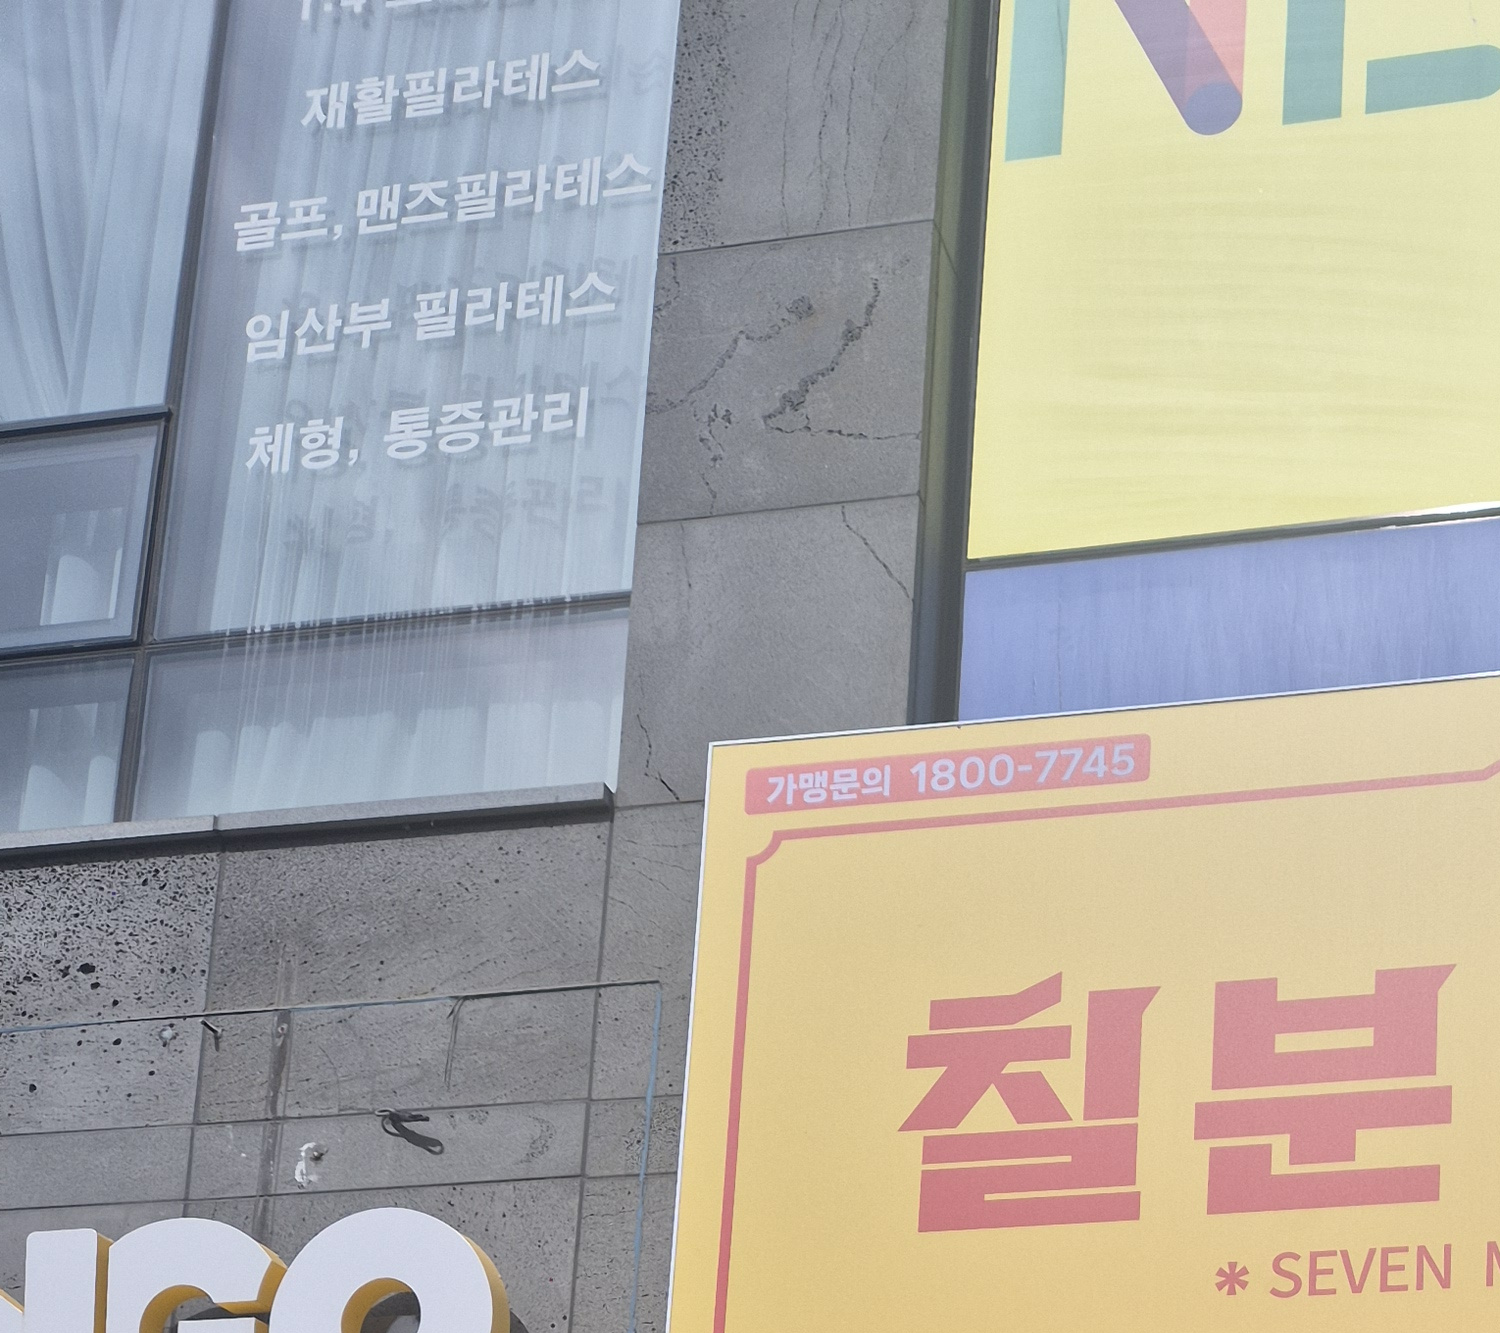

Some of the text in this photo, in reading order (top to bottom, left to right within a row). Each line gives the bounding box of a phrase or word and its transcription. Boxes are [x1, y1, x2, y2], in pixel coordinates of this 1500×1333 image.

[301, 49, 601, 130] 재활필라테스
[233, 154, 654, 253] 골프, 맨즈필라테스
[245, 269, 618, 364] 임산부 필라테스
[245, 388, 590, 475] 체형, 통증관리
[766, 741, 1137, 806] 가맹문의 1800-7745
[897, 964, 1456, 1234] 칠분
[1269, 1242, 1455, 1300] SEVEN
